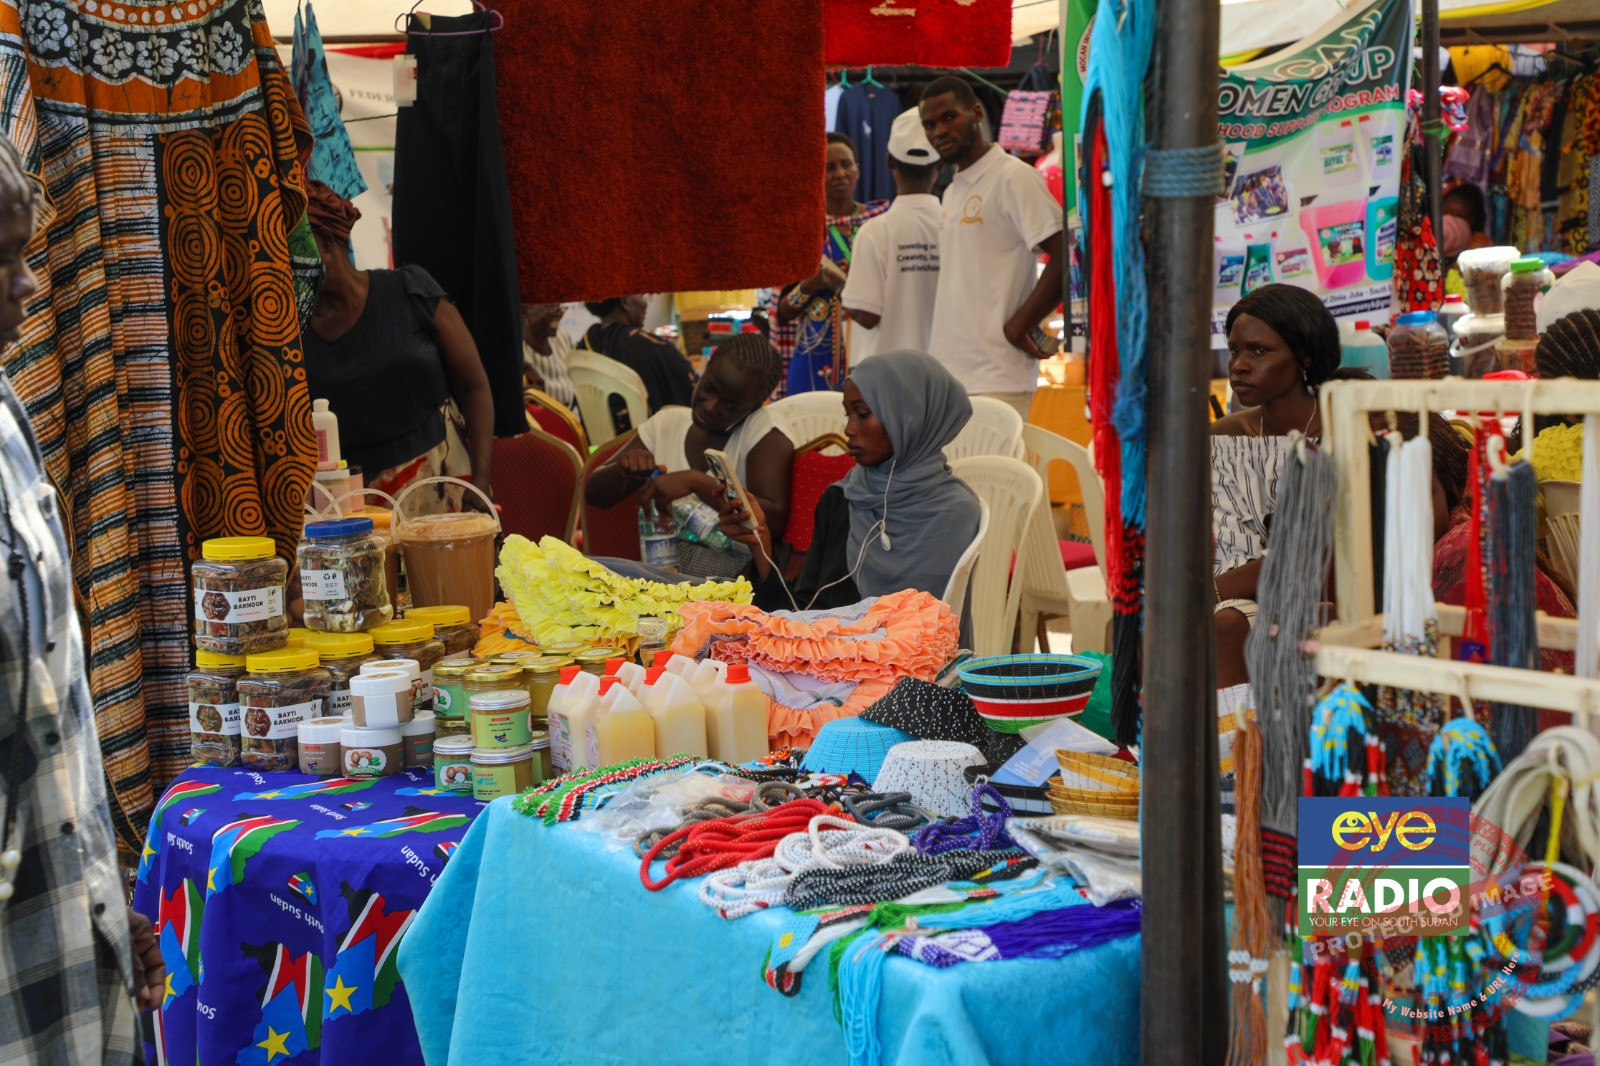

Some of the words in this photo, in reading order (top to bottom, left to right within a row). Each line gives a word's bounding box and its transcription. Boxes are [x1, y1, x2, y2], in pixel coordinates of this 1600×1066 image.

[1217, 82, 1313, 117] OMEN
[1217, 121, 1266, 139] HOOD
[1325, 86, 1400, 113] OGRAM
[233, 601, 264, 610] BAKHOOR
[238, 595, 257, 603] BAYTI
[273, 716, 304, 726] BAKHOOR
[277, 710, 297, 719] BAYTI
[400, 845, 431, 878] Sudan
[270, 893, 302, 920] Sudan
[305, 913, 325, 935] outh
[196, 998, 217, 1020] Sou
